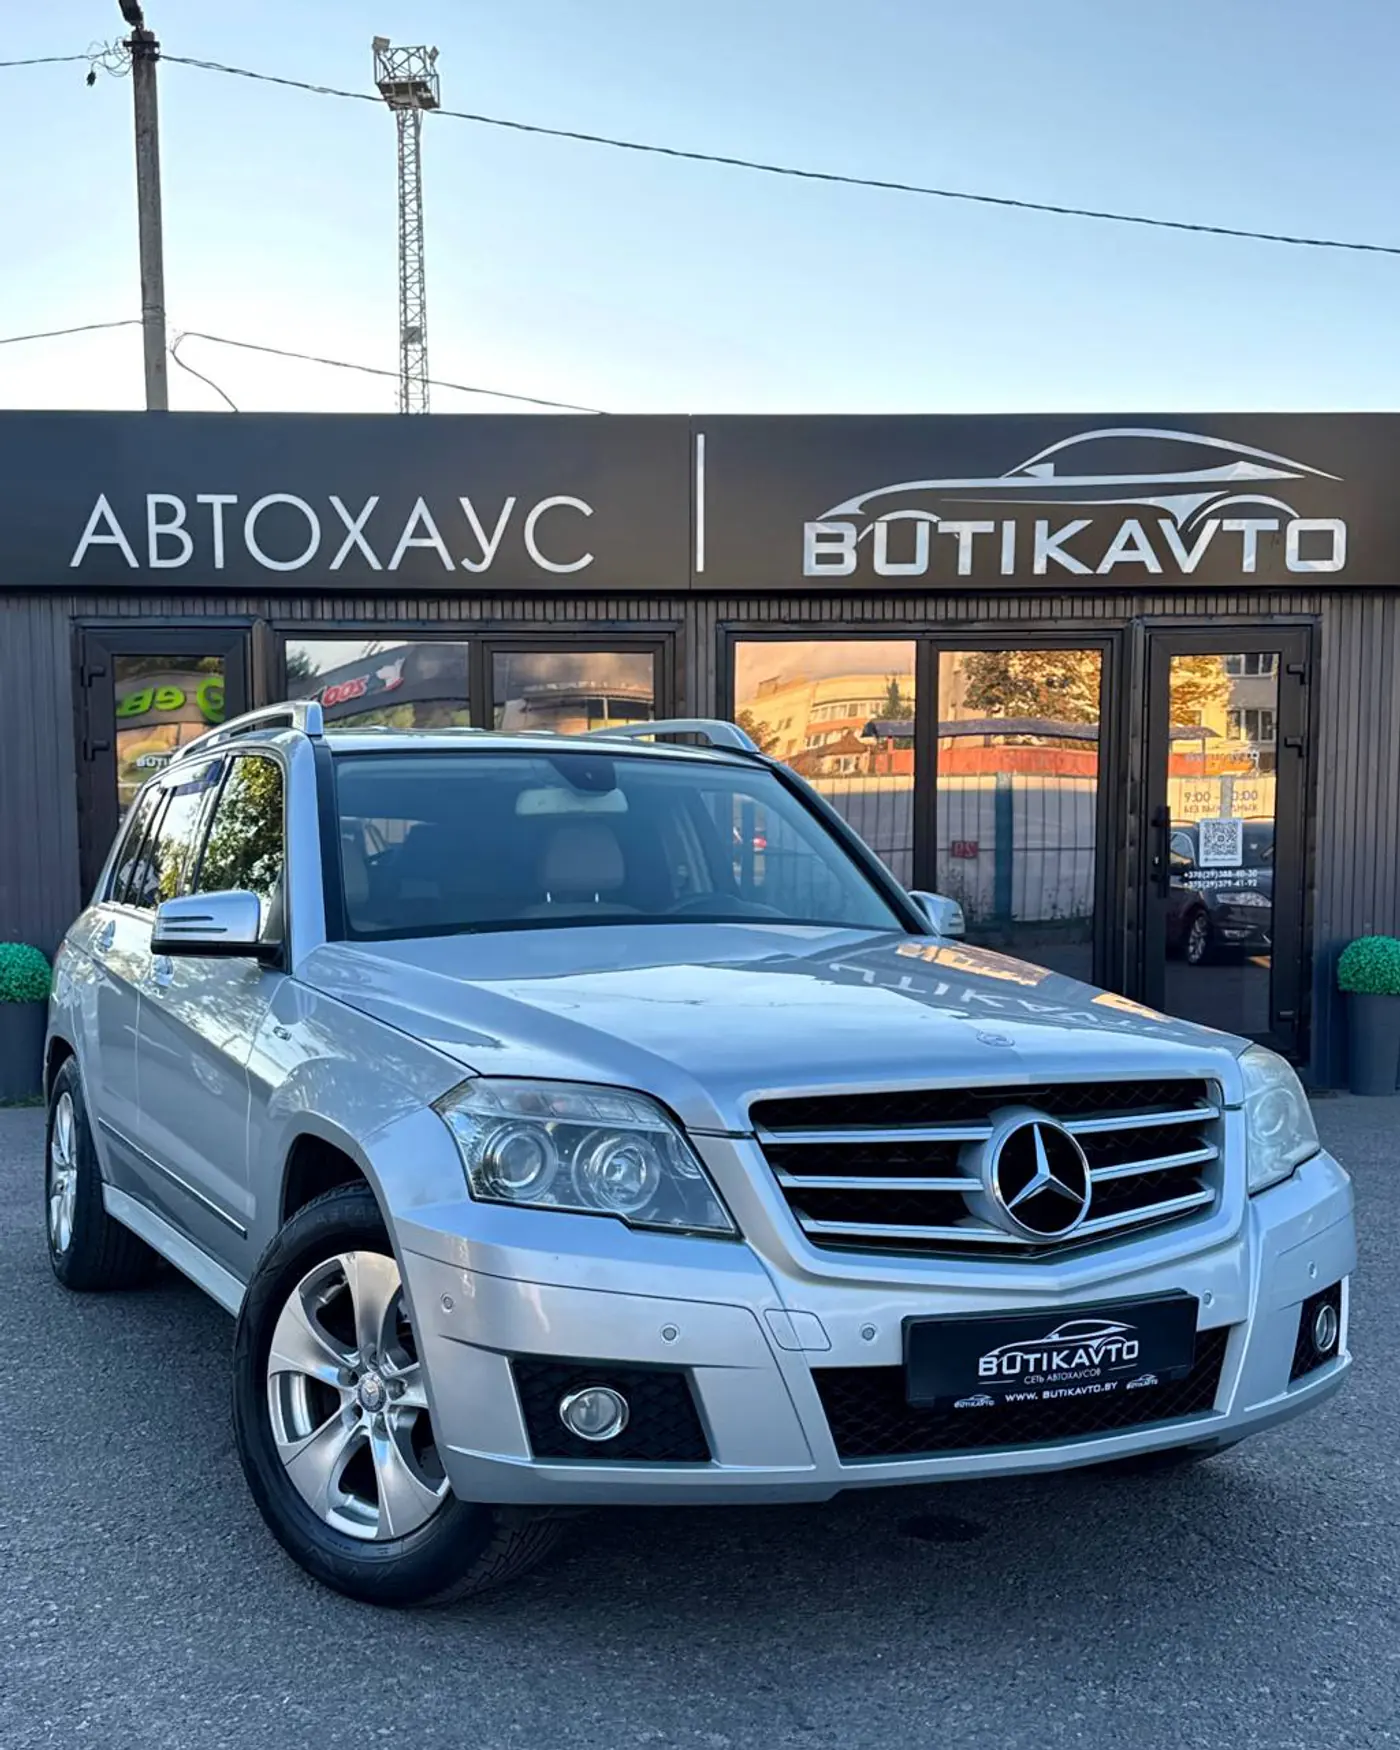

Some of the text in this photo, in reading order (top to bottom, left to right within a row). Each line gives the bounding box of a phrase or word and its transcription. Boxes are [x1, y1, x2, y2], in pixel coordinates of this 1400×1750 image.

[70, 493, 594, 574] АВТОХАУС
[803, 517, 1347, 577] BUTIKAVTO
[977, 1340, 1139, 1377] BUTIKAVTO
[1023, 1368, 1101, 1385] СЕТЬ АВТОХАУСОВ
[1042, 1381, 1118, 1399] BUTIKAVTO.BY
